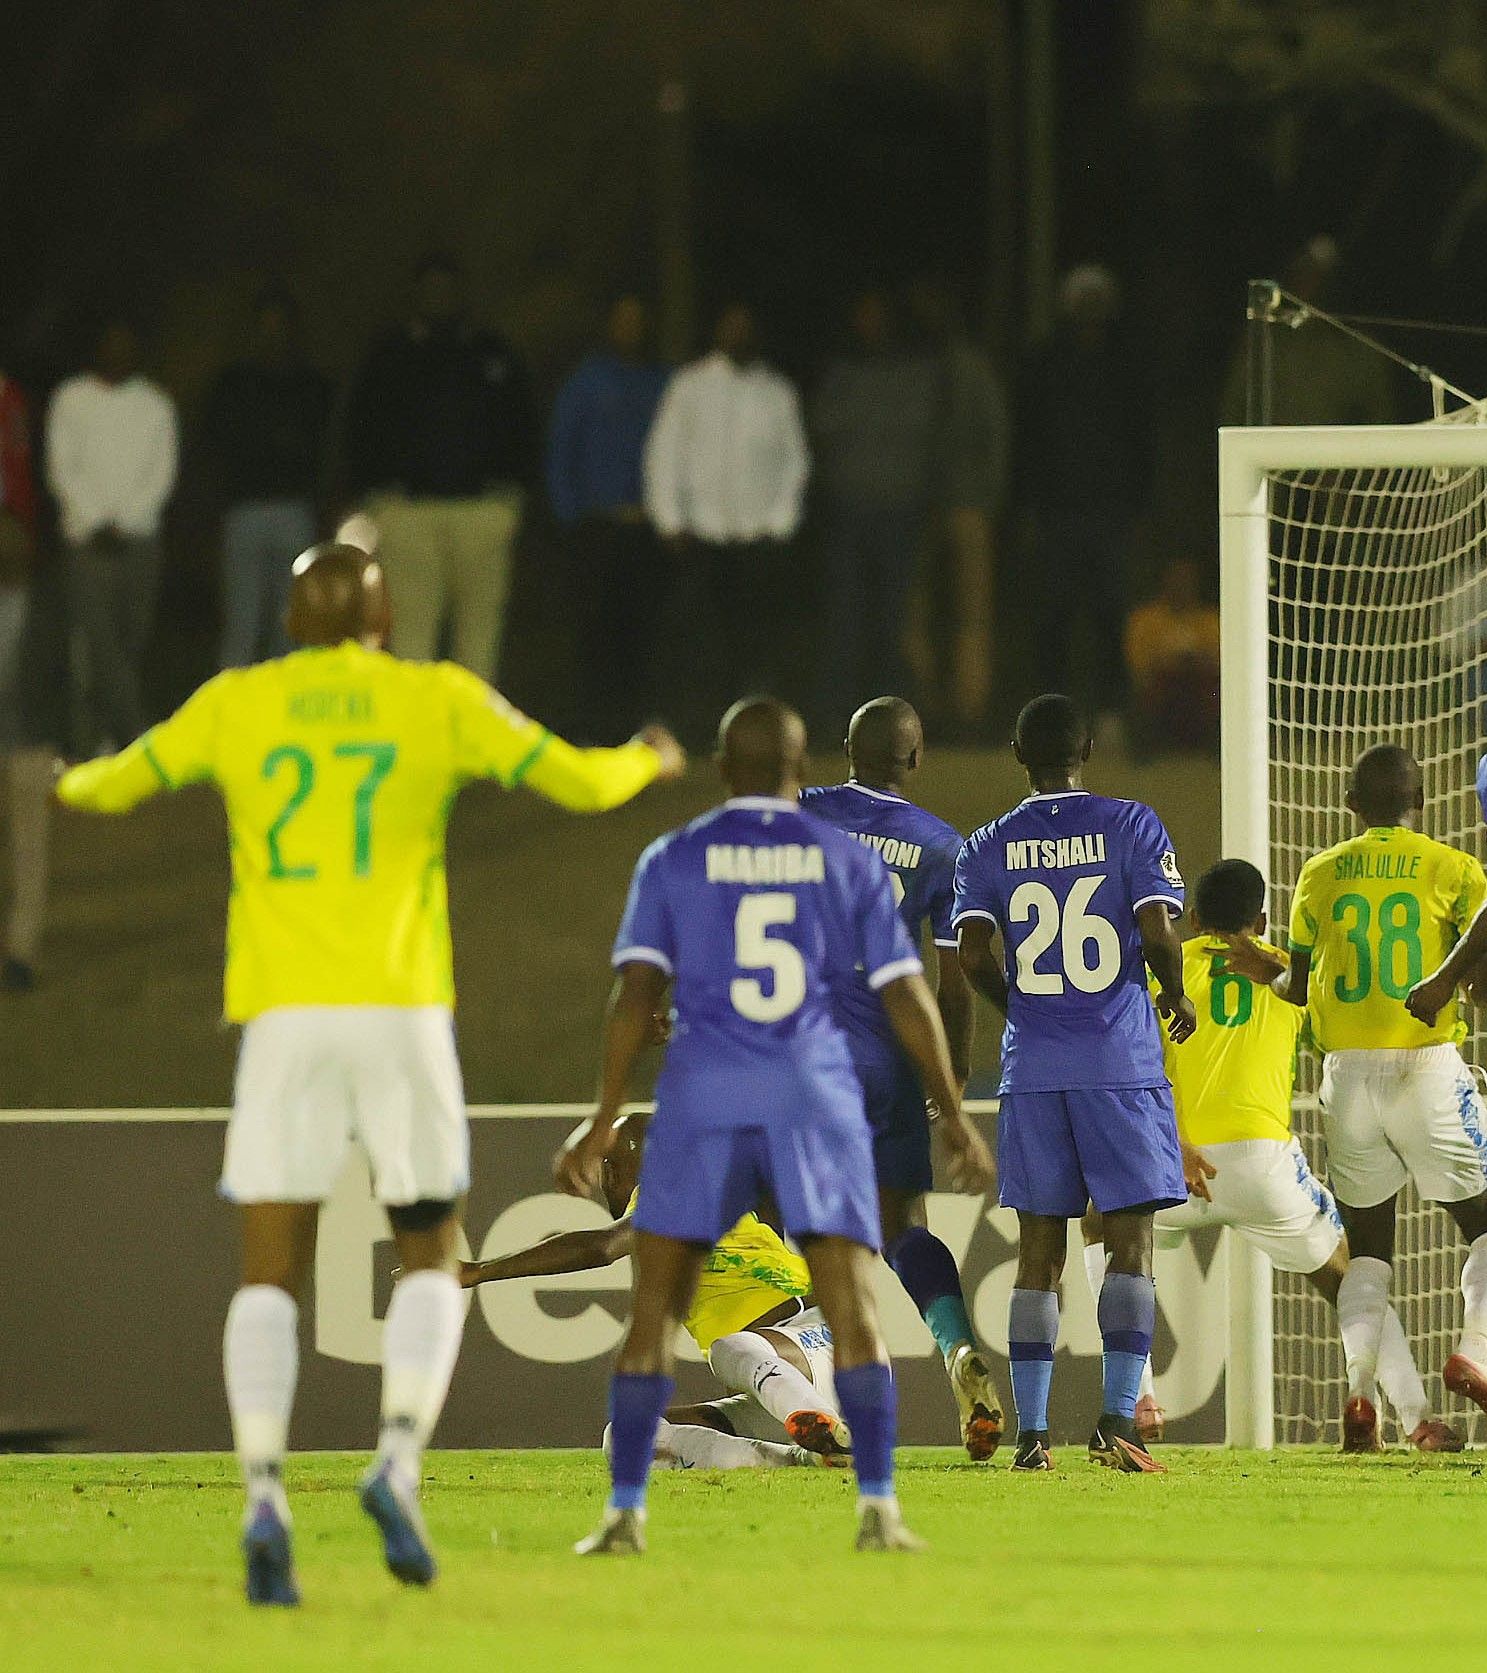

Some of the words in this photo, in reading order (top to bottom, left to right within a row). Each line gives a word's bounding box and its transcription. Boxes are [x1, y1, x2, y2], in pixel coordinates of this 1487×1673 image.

[262, 742, 397, 878] 27
[1006, 833, 1106, 870] MTSHALI
[1334, 853, 1422, 881] SHALULILE
[729, 892, 807, 1024] 5
[1008, 874, 1121, 996] 26
[1210, 953, 1253, 1028] 6
[1332, 892, 1423, 1004] 38
